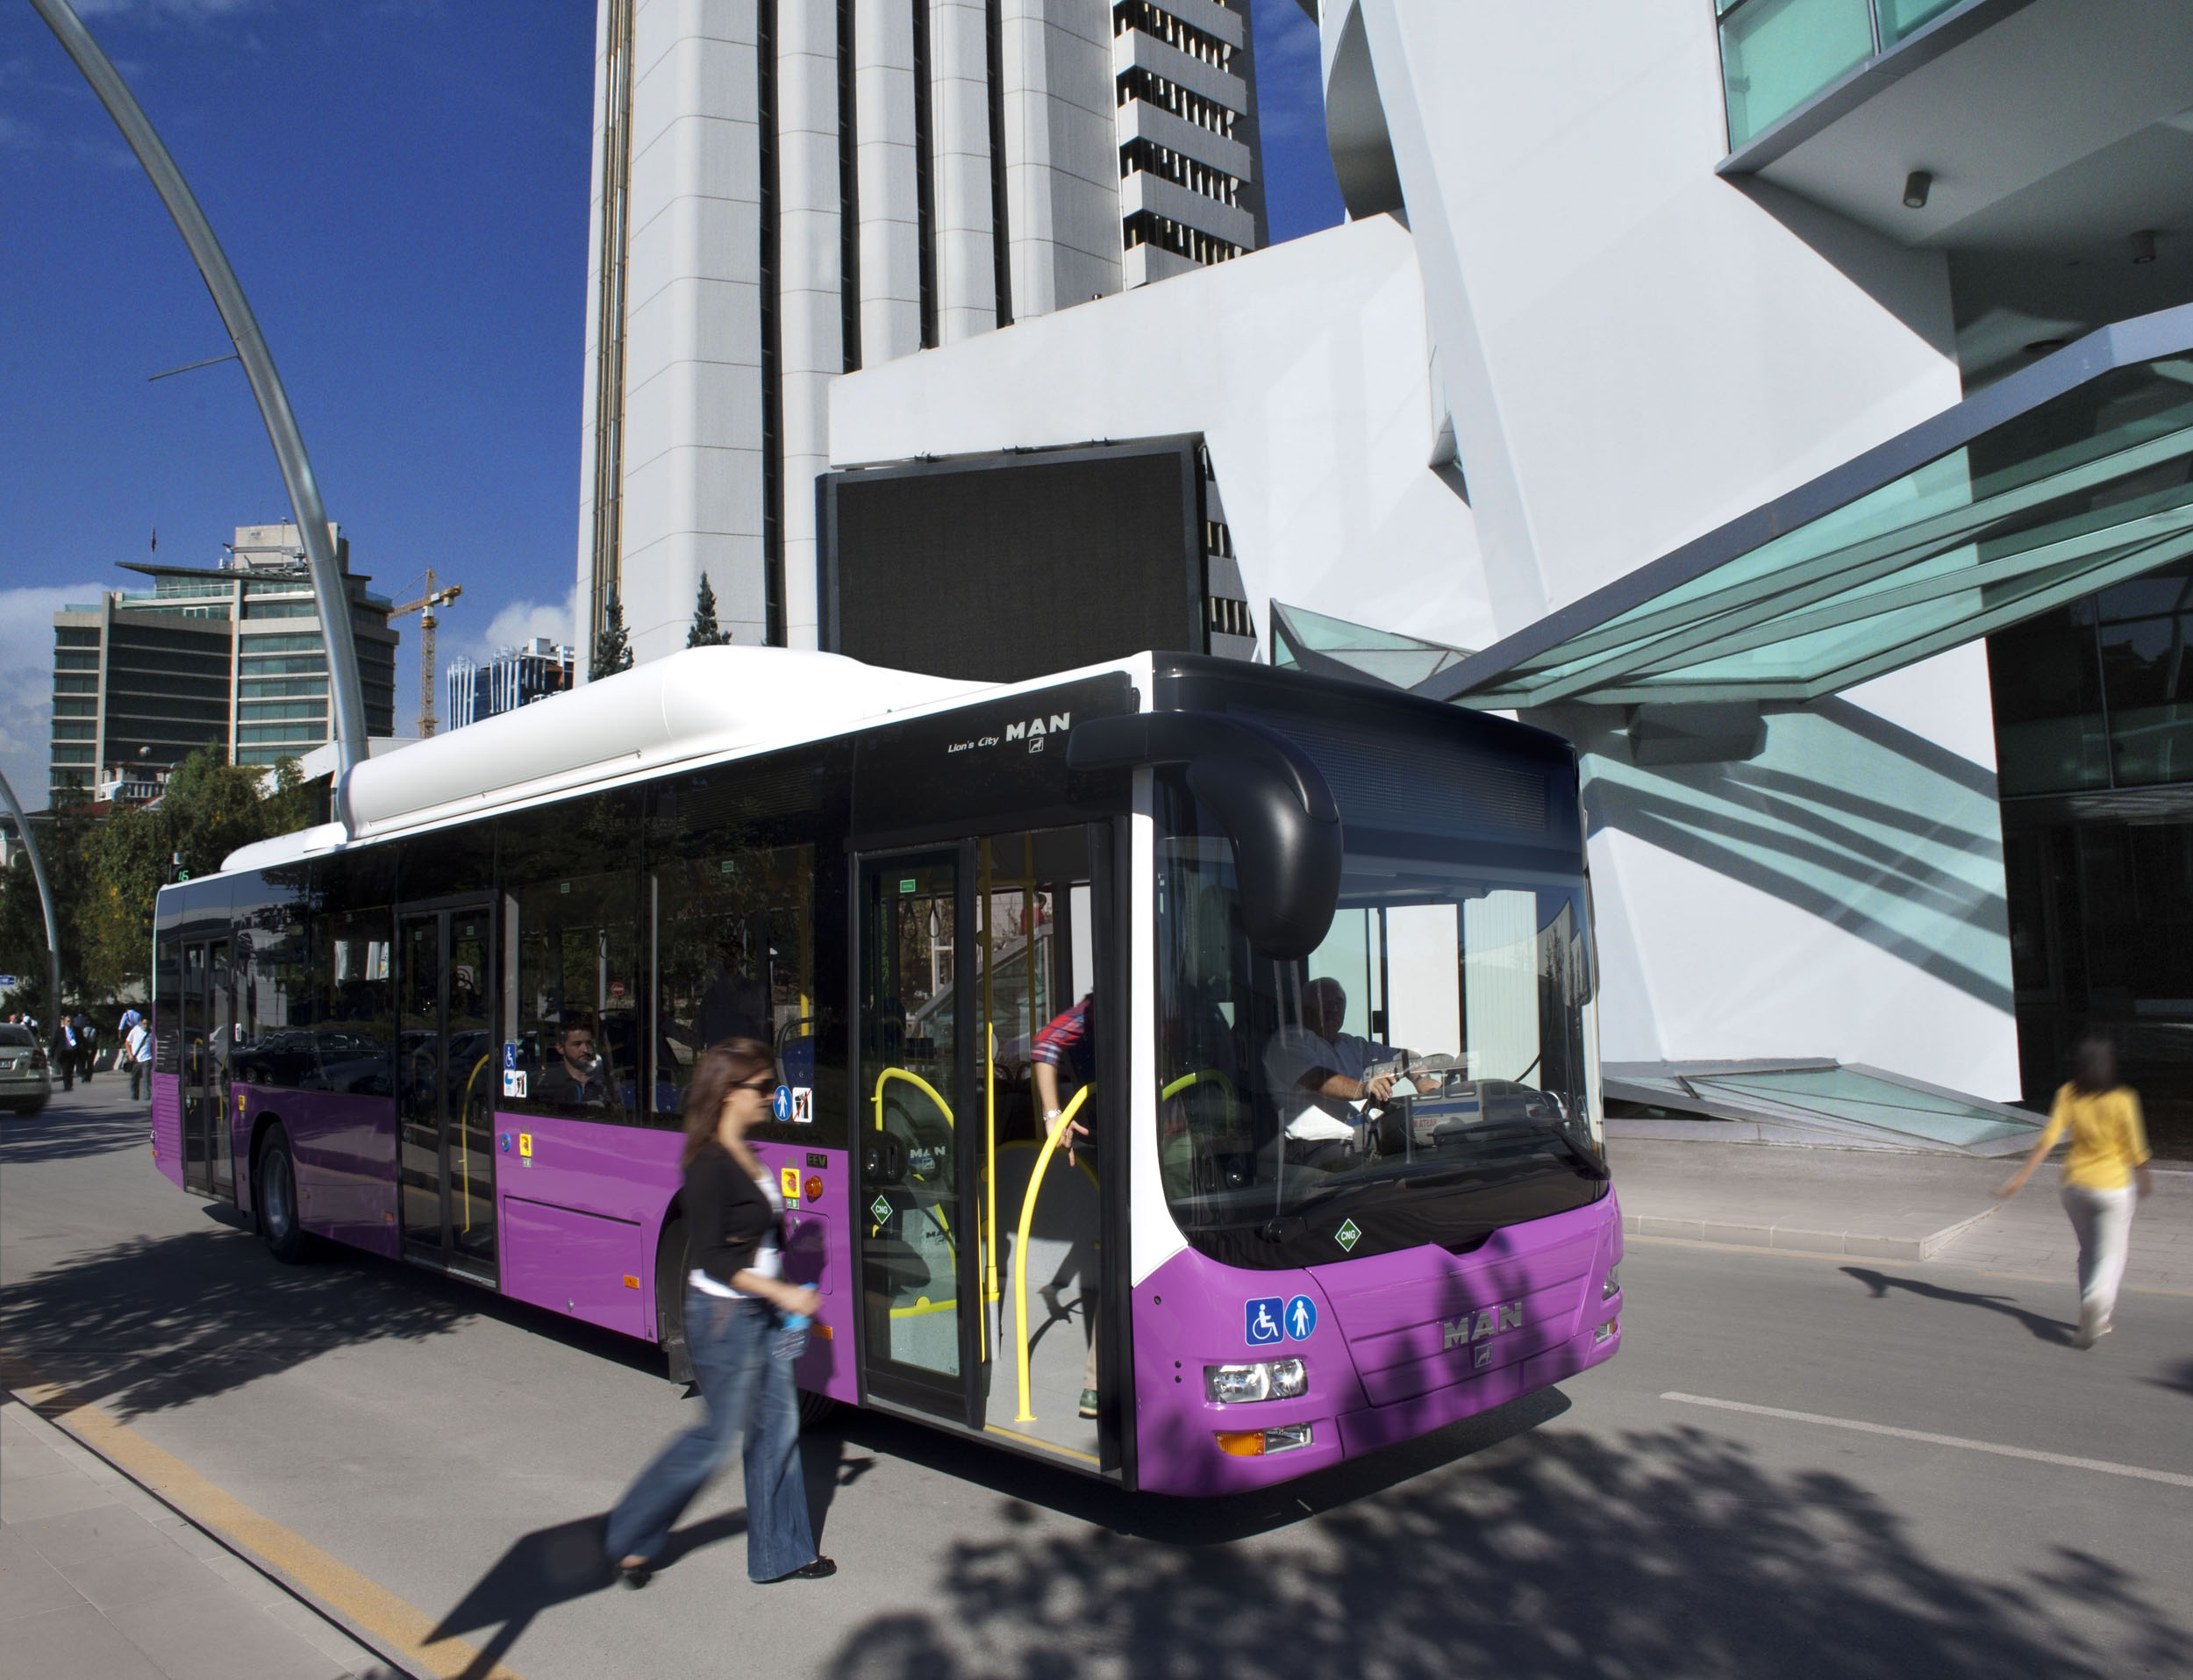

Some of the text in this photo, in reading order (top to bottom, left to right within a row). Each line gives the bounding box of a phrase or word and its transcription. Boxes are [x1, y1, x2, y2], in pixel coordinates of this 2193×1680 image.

[1005, 711, 1070, 742] MAN
[947, 737, 1000, 754] Lion's City
[177, 869, 189, 882] 16
[807, 1154, 826, 1167] EEV
[875, 1205, 889, 1215] CNG
[1340, 1230, 1356, 1240] CNG
[1443, 1302, 1522, 1349] MAN
